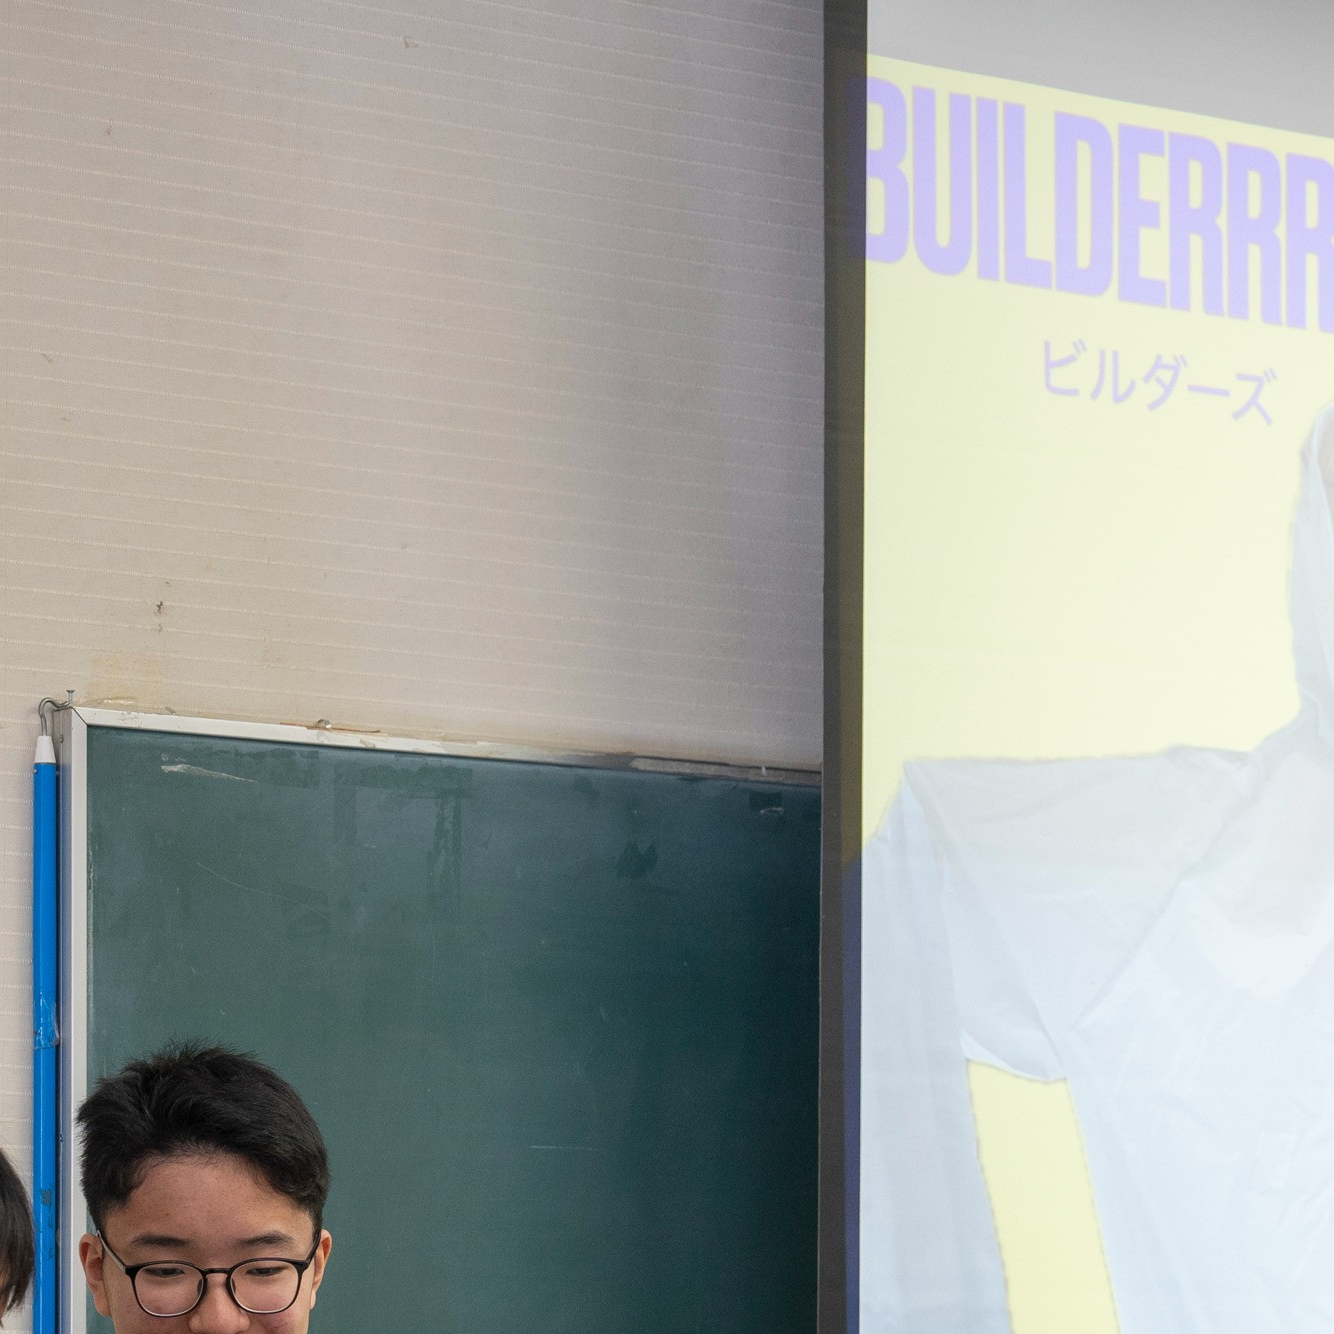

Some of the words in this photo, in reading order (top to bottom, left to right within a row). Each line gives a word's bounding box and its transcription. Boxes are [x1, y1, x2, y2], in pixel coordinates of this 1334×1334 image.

[1043, 338, 1278, 426] ビルダーズ
